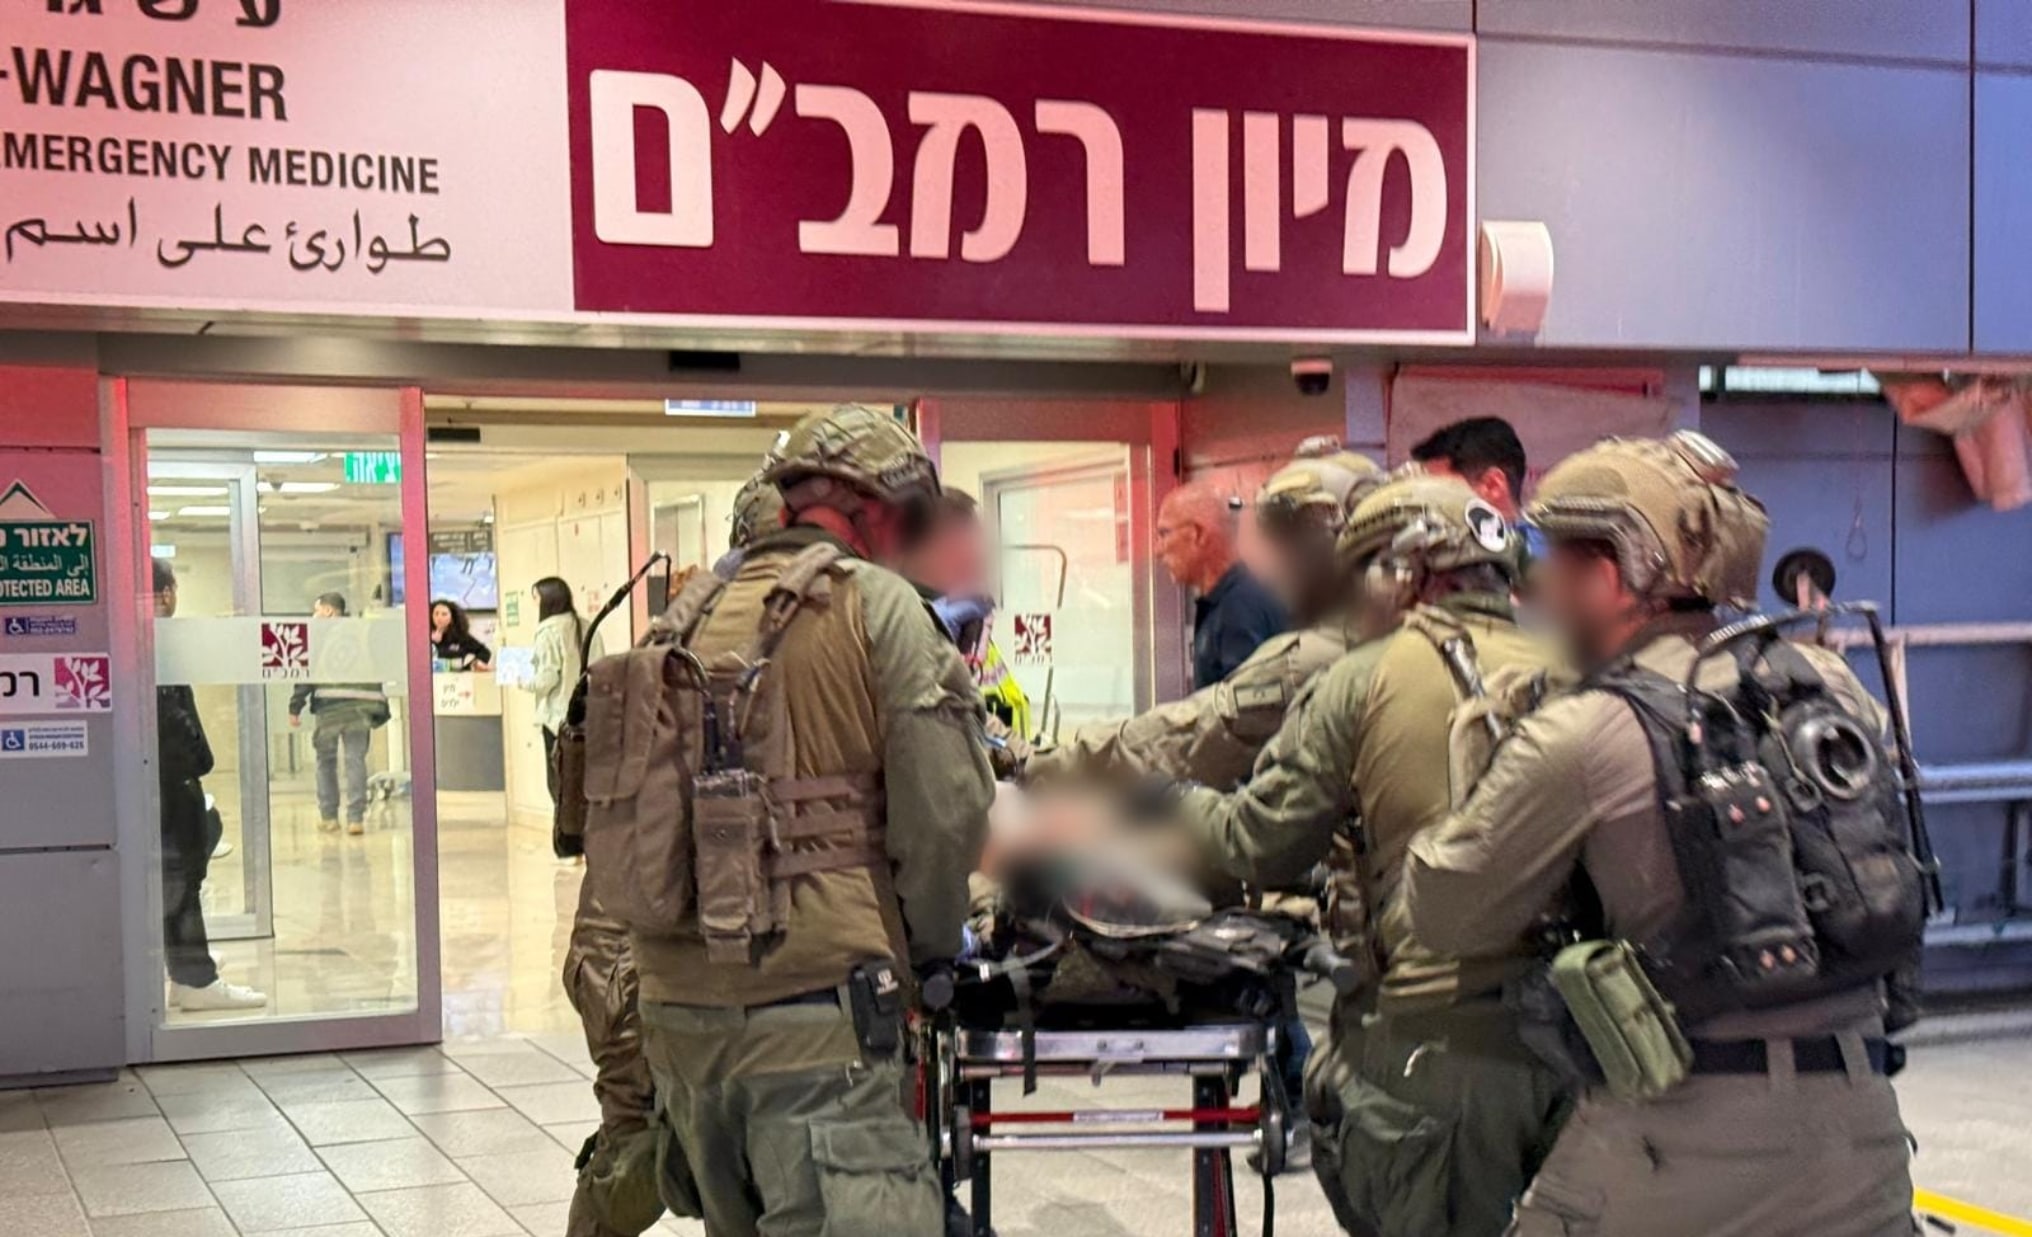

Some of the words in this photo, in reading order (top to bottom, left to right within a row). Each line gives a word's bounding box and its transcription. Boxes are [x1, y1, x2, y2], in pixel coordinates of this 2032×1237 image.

[0, 132, 232, 181] MERGENCY
[248, 146, 440, 194] MEDICINE
[589, 57, 1125, 265] רמב"ם
[5, 196, 138, 263] اسم
[157, 202, 272, 269] على
[284, 209, 452, 274] طوارئ
[1192, 108, 1448, 313] מיון
[13, 523, 87, 547] לאזור
[55, 578, 90, 597] AREA
